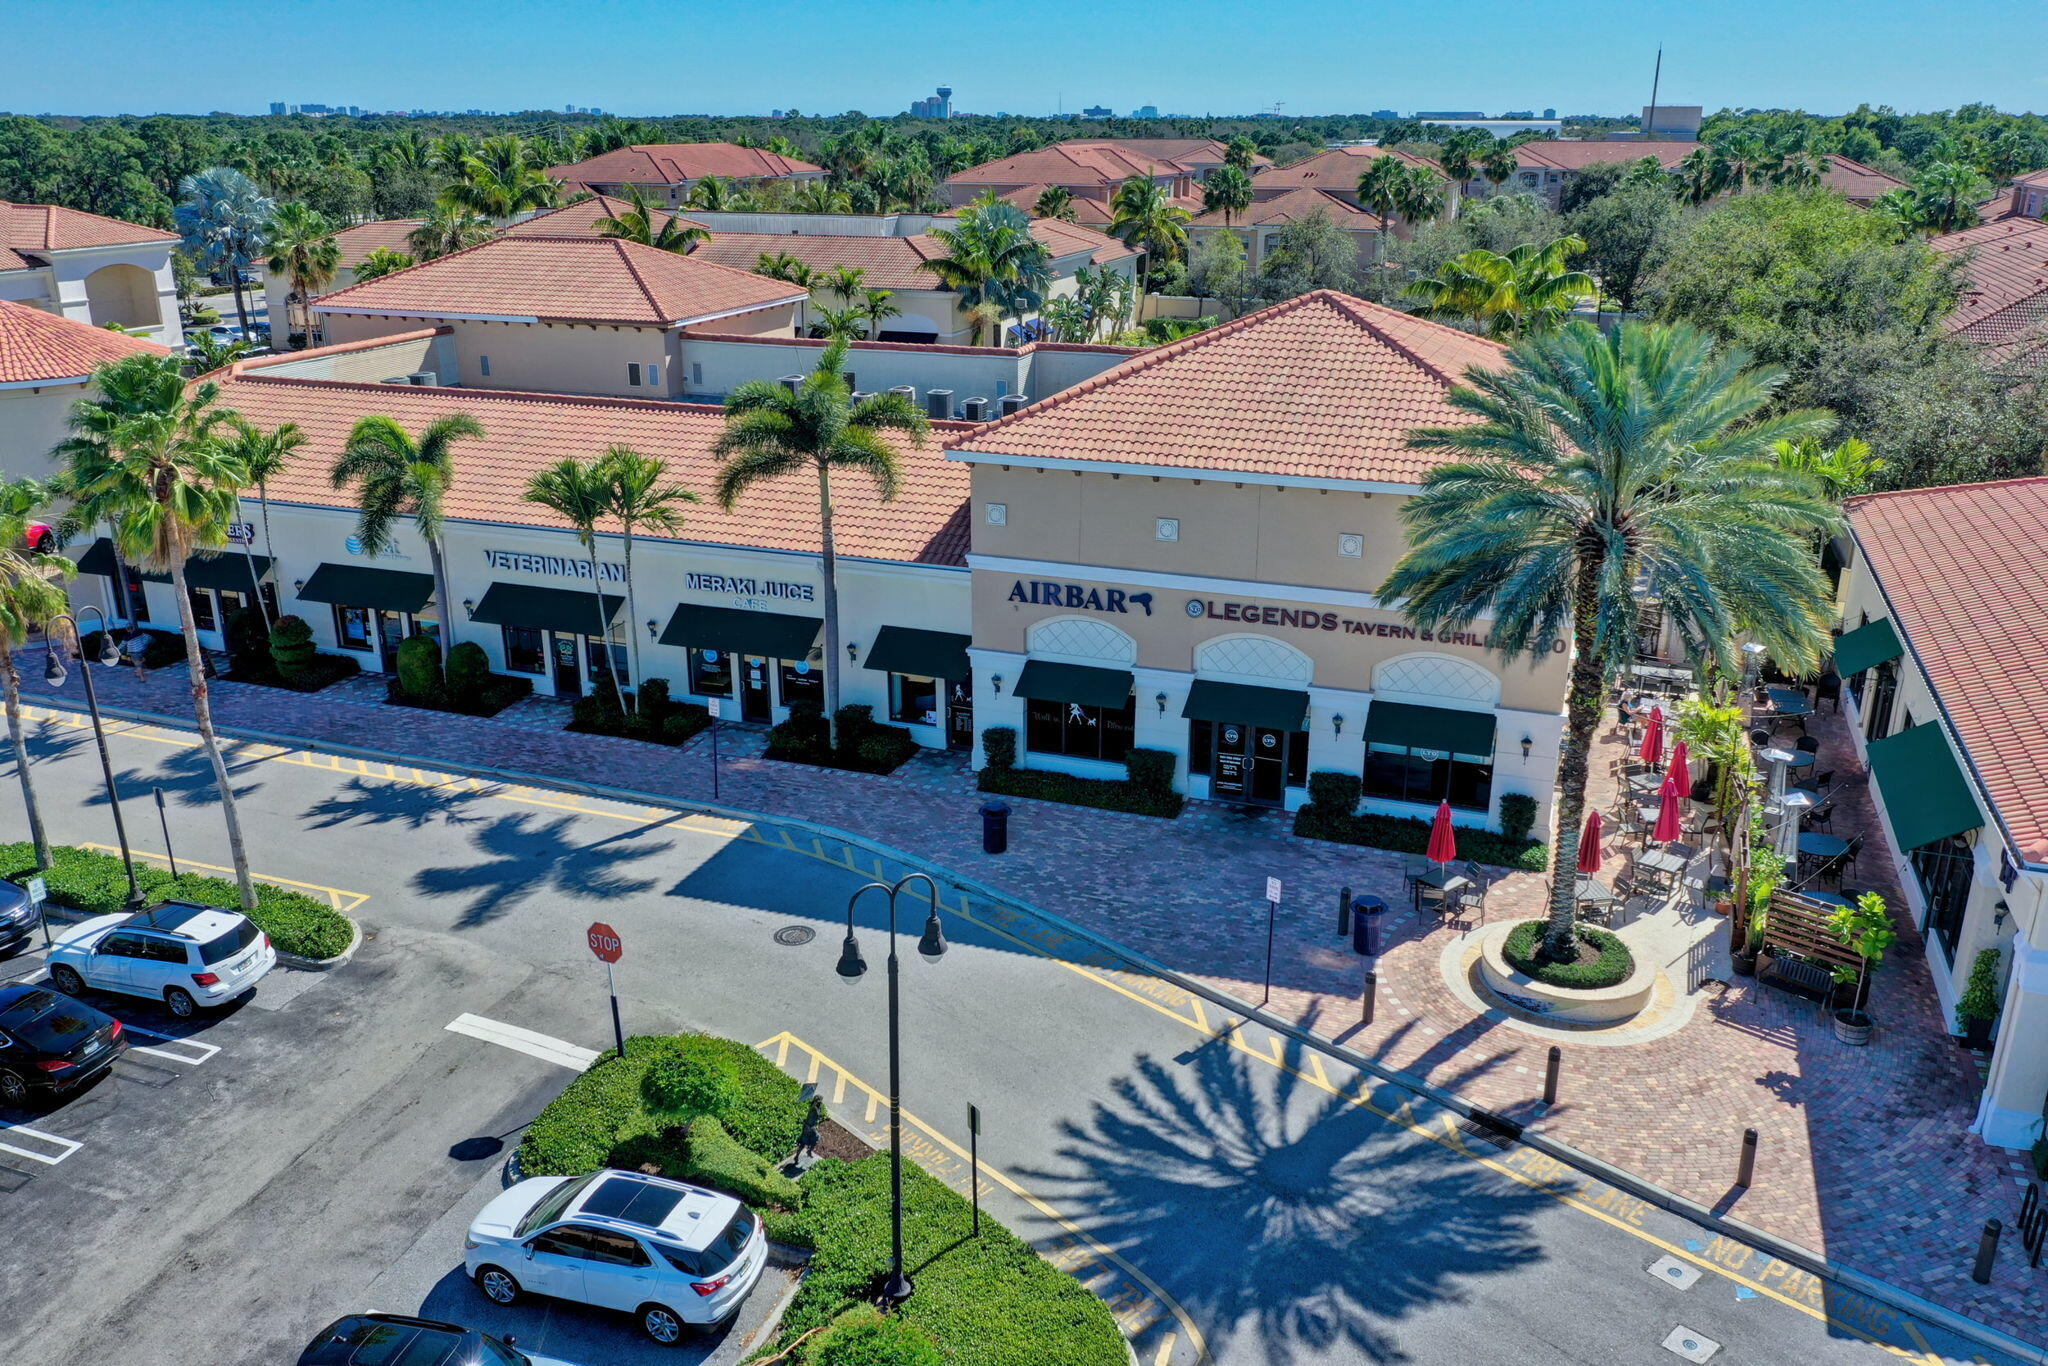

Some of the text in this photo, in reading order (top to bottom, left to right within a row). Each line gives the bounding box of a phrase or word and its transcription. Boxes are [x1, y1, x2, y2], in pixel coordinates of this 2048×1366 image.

[484, 550, 626, 582] VETERINARIAN
[685, 573, 814, 603] MERAKI JUICE
[733, 597, 768, 610] CAFE
[1008, 580, 1128, 613] AIRBAR
[1207, 601, 1338, 631] LEGENDS
[1342, 620, 1416, 640] TAVERN
[1421, 629, 1434, 641] &
[590, 933, 619, 952] STOP
[1505, 1147, 1898, 1334] FIRE LANE NO PARKING
